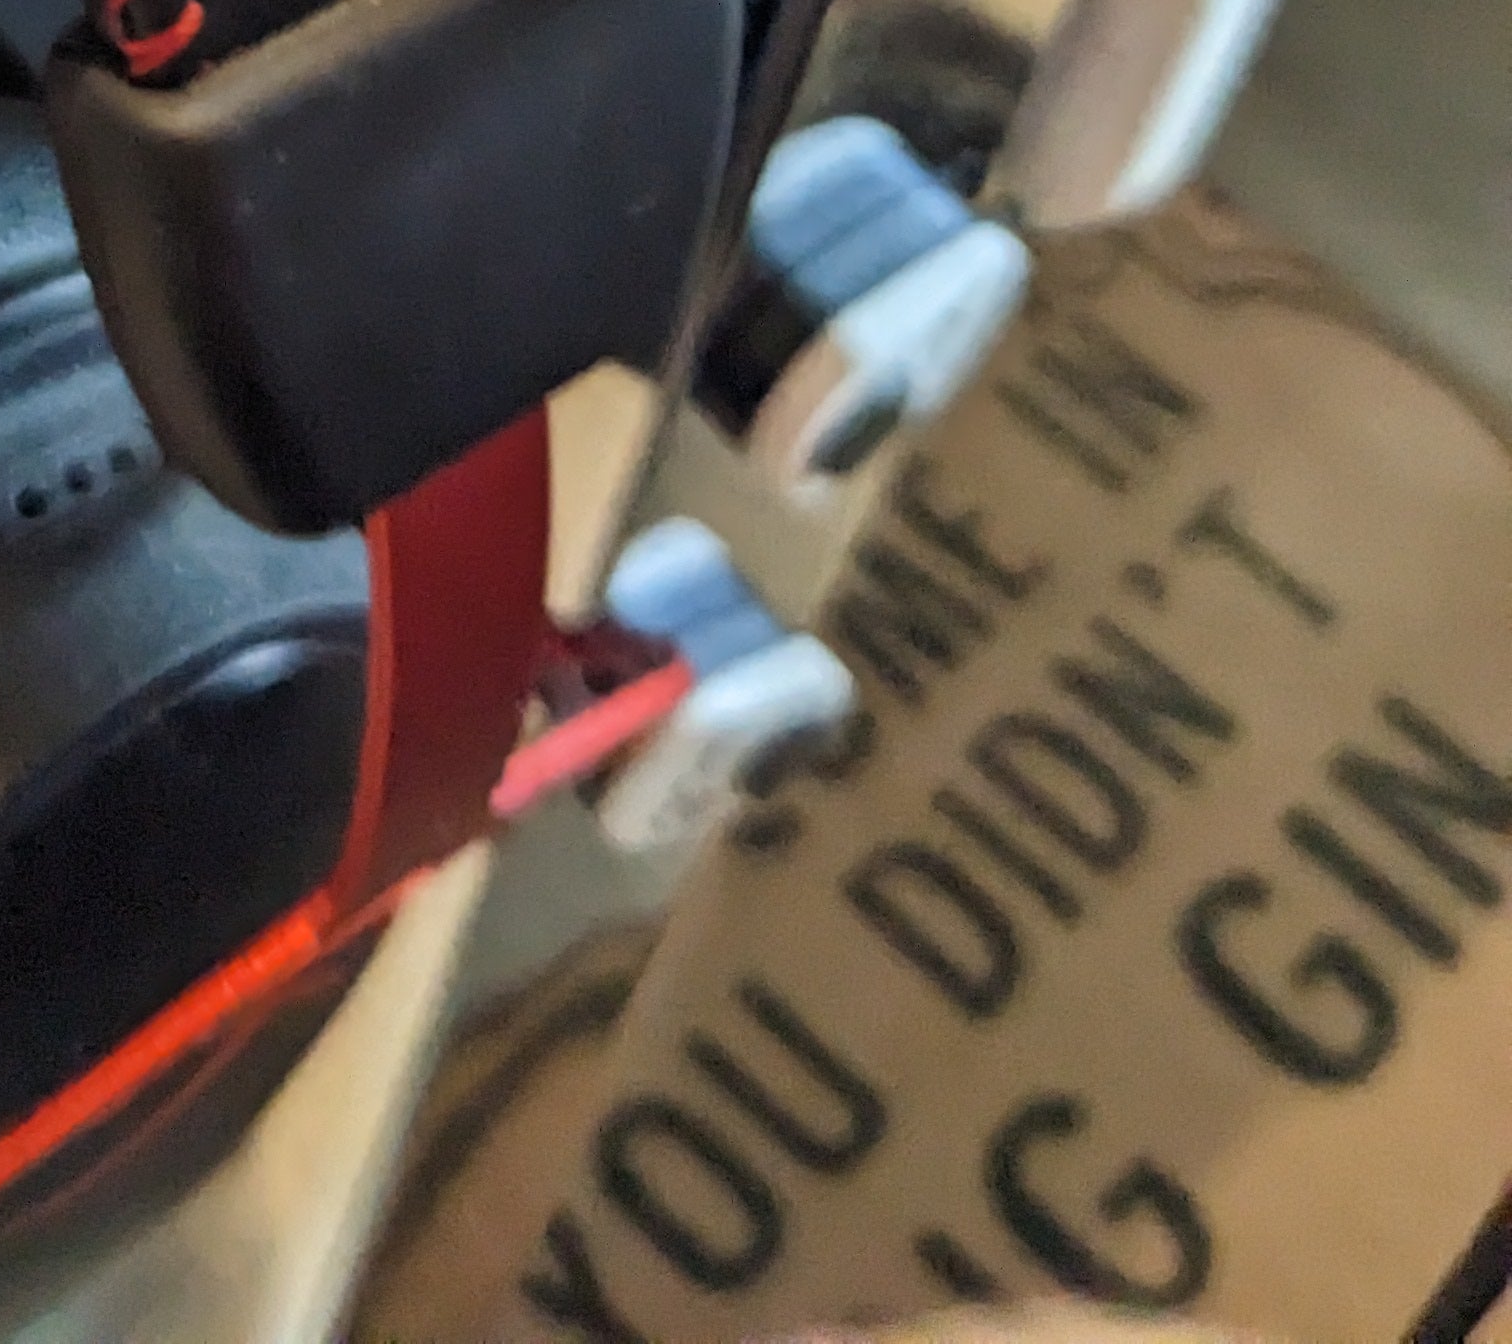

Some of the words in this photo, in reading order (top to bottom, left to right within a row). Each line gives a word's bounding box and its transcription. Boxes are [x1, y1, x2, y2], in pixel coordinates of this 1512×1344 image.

[993, 312, 1208, 496] IN
[522, 980, 890, 1344] YOU
[842, 484, 1338, 1020] DIDN'T
[1176, 692, 1512, 1088] GIN
